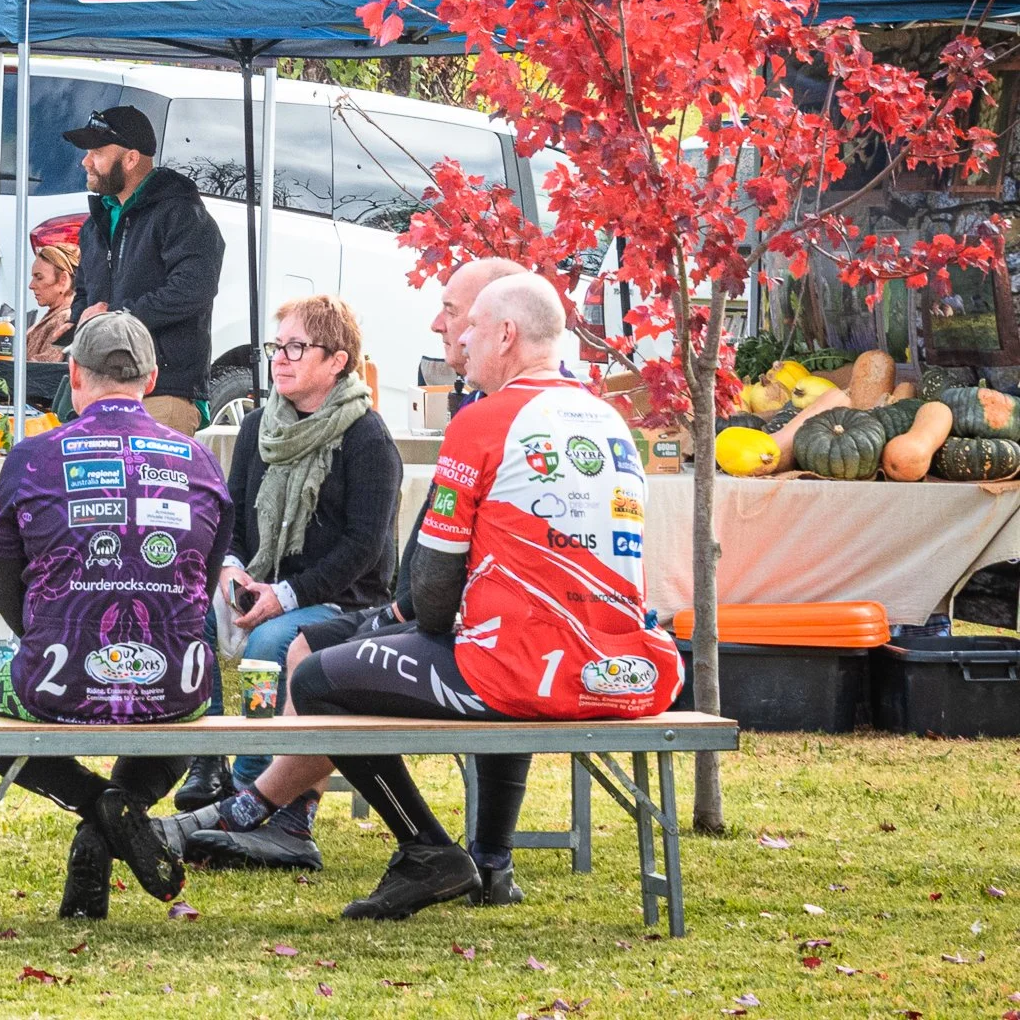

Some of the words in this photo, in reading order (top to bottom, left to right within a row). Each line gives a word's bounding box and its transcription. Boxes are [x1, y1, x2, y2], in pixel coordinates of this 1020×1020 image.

[146, 441, 188, 454] GIANT
[87, 469, 120, 479] regional
[140, 464, 188, 484] focus
[71, 479, 99, 488] australia
[100, 477, 120, 485] bank
[568, 491, 590, 500] cloud
[73, 503, 122, 518] FINDEX
[434, 492, 454, 516] life
[570, 509, 586, 518] film
[547, 527, 597, 549] focus
[70, 578, 185, 594] tourderocks.com.au
[35, 643, 69, 696] 2
[181, 641, 206, 693] 0
[537, 649, 565, 698] 1
